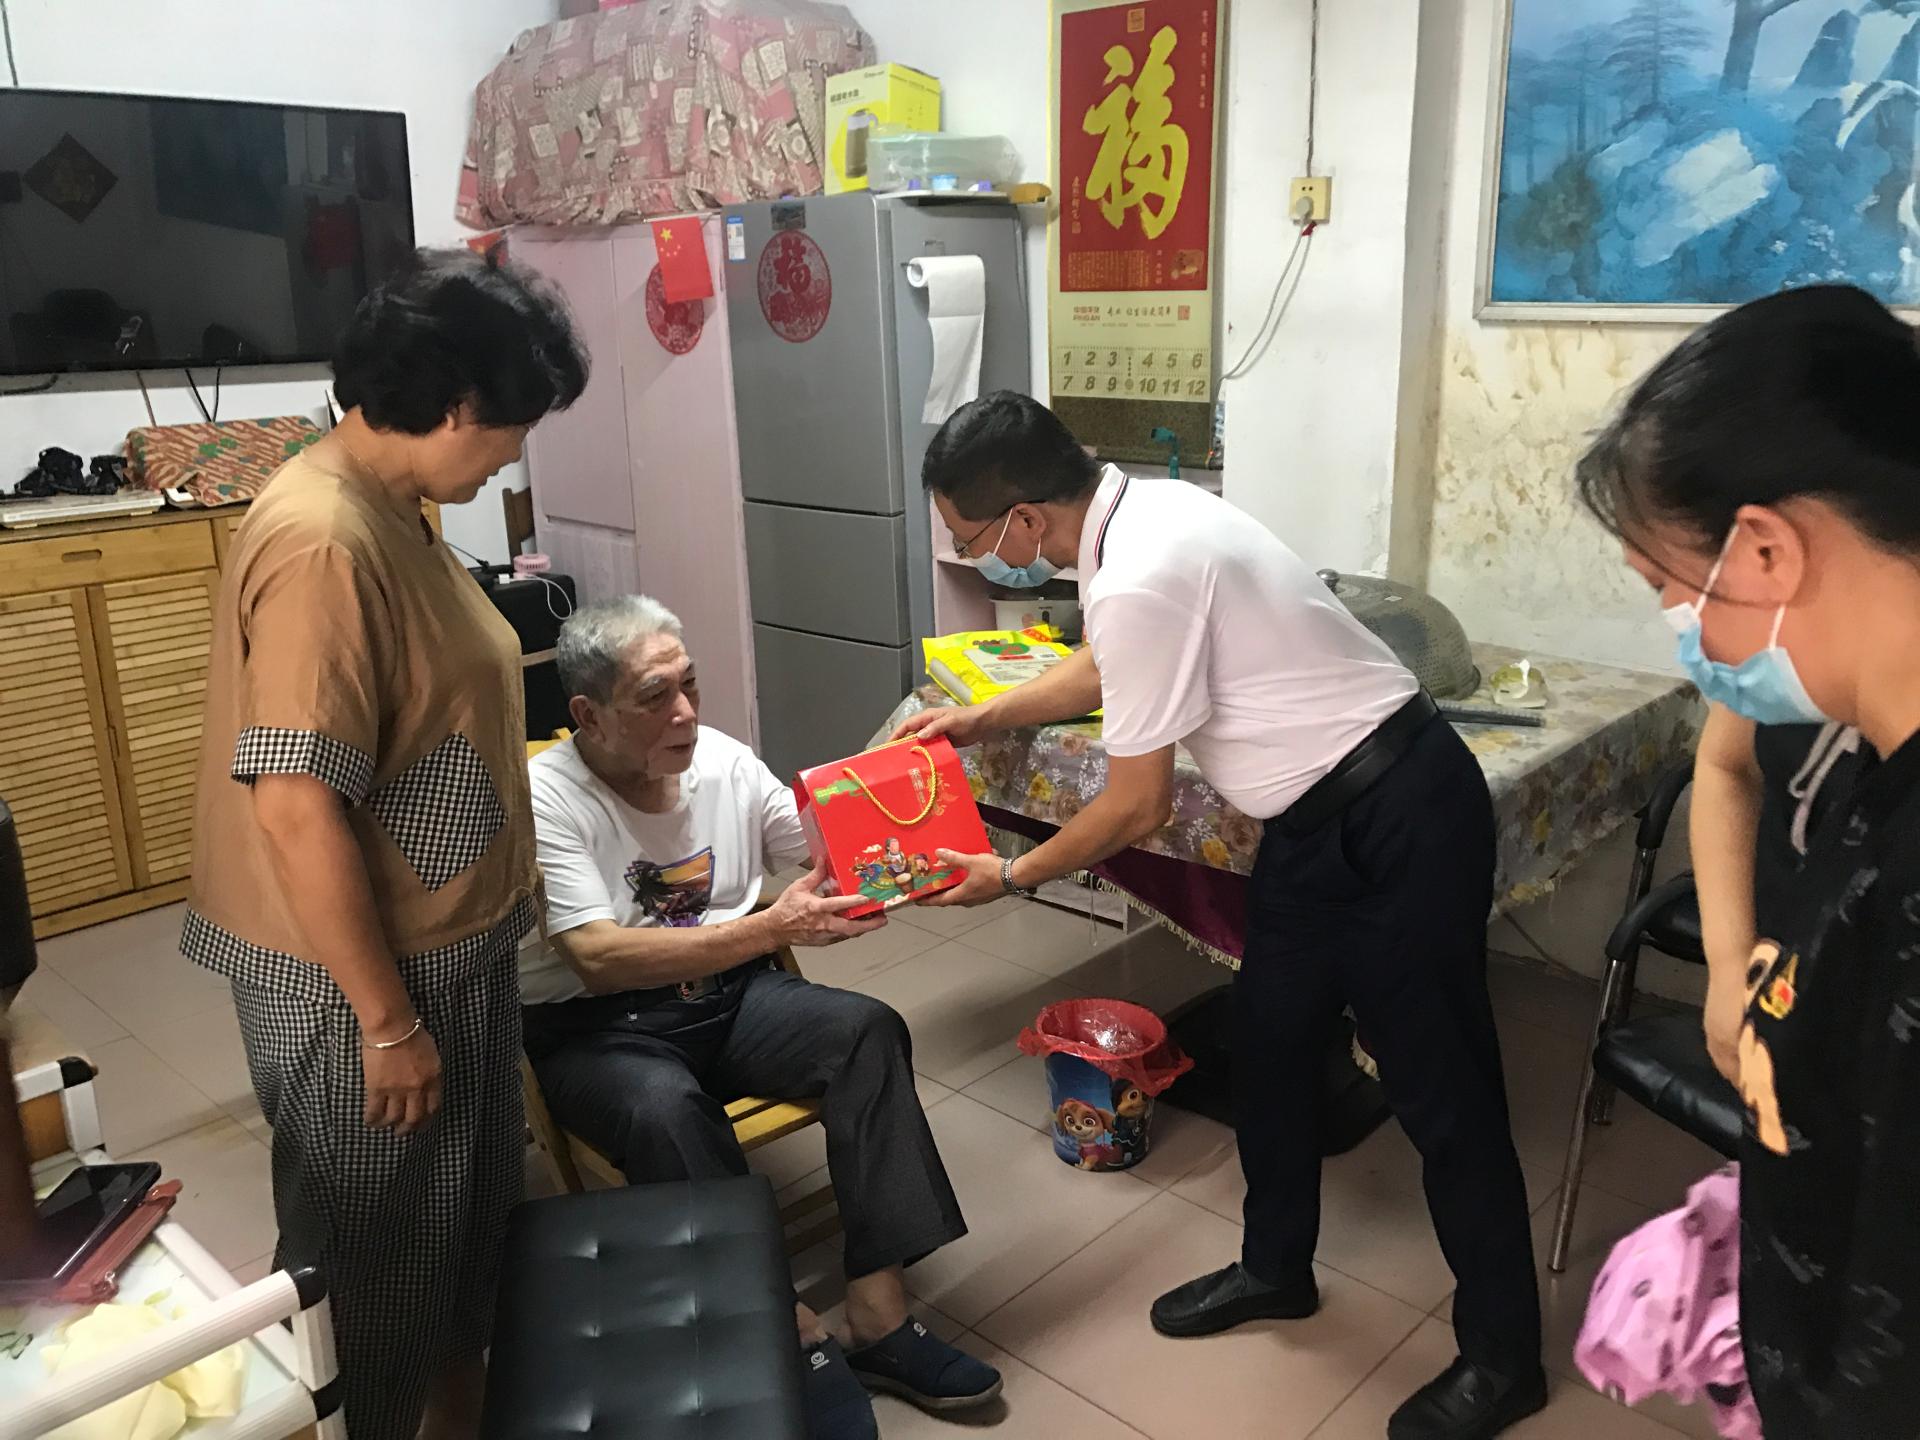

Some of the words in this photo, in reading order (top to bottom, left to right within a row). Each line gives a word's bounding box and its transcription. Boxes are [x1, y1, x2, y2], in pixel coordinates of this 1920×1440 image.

[1082, 25, 1189, 240] 福
[1063, 352, 1071, 366] 1
[1085, 352, 1096, 366] 2
[1107, 352, 1117, 366] 3
[1142, 353, 1153, 368] 4
[1166, 354, 1177, 368] 5
[1191, 353, 1203, 368] 6
[1063, 376, 1073, 390] 7
[1085, 376, 1095, 390] 8
[1107, 376, 1117, 391] 9
[1139, 378, 1157, 393] 10
[1162, 379, 1180, 394] 11
[1186, 380, 1206, 395] 12
